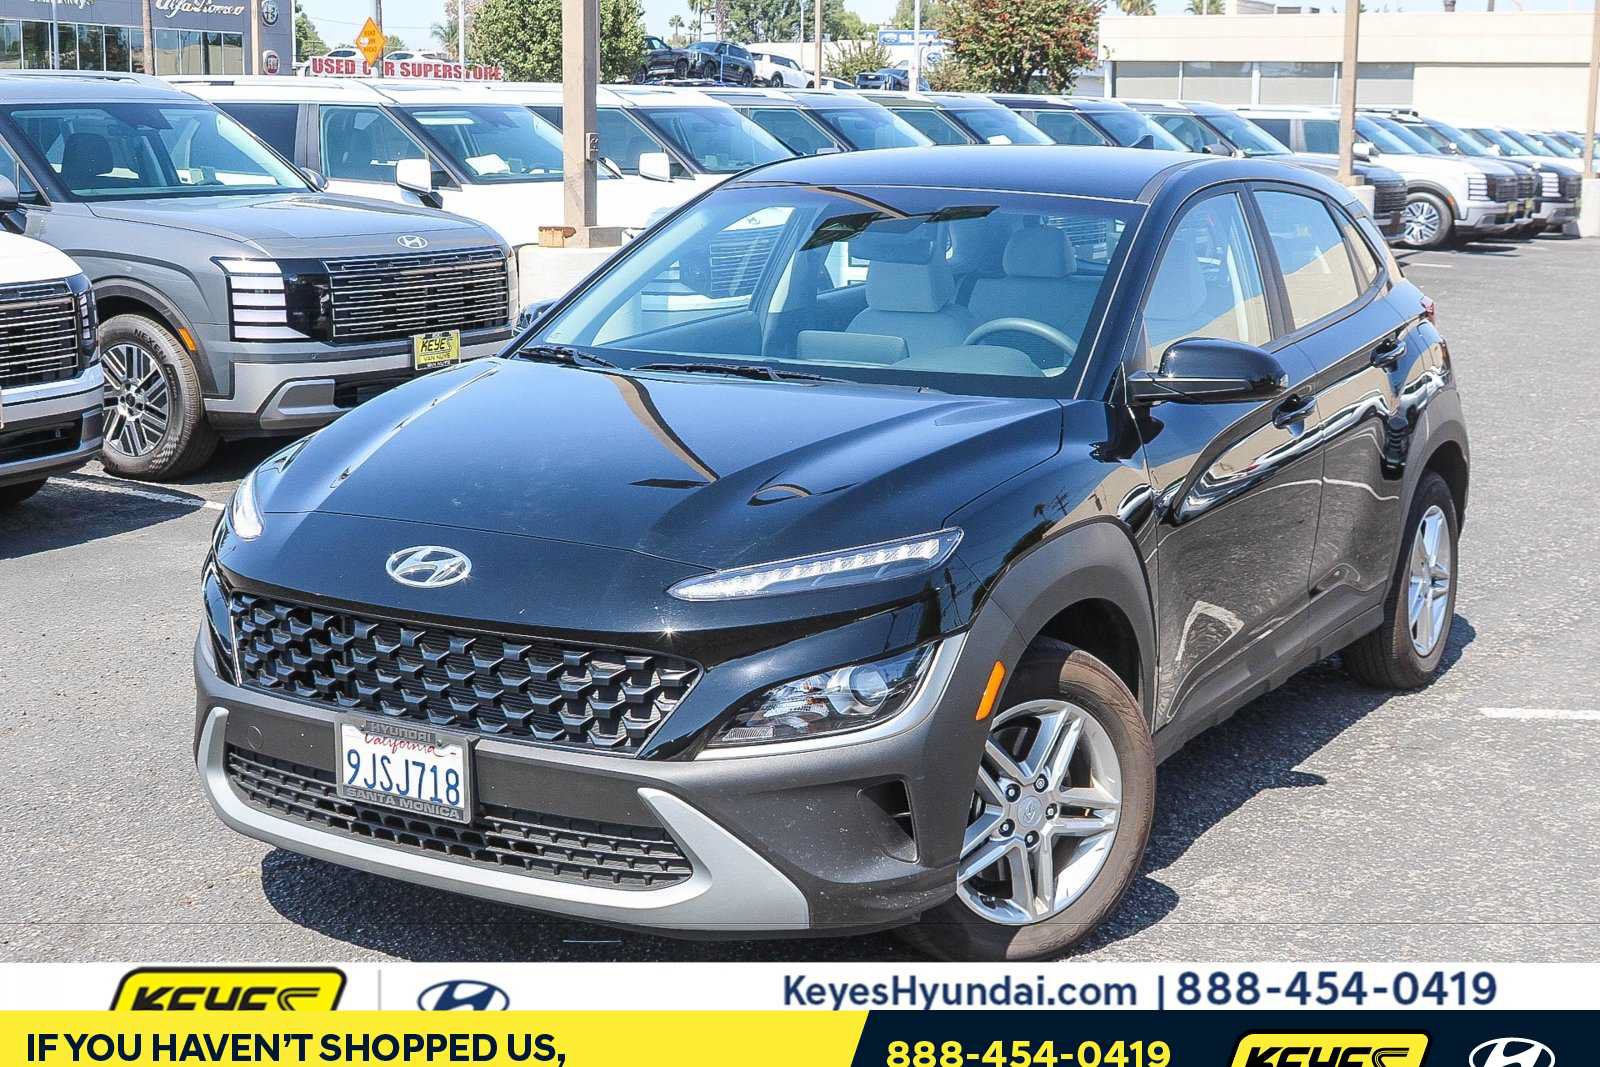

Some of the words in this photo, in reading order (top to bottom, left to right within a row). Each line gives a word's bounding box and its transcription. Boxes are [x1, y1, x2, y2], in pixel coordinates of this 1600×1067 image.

[312, 58, 356, 74] USED
[362, 60, 395, 76] CR
[134, 328, 167, 360] NEXEN
[364, 733, 443, 757] California
[369, 721, 435, 743] HYUNDAI
[347, 748, 460, 806] 9JSJ718
[348, 788, 396, 807] SANTA
[399, 799, 461, 820] MONICA
